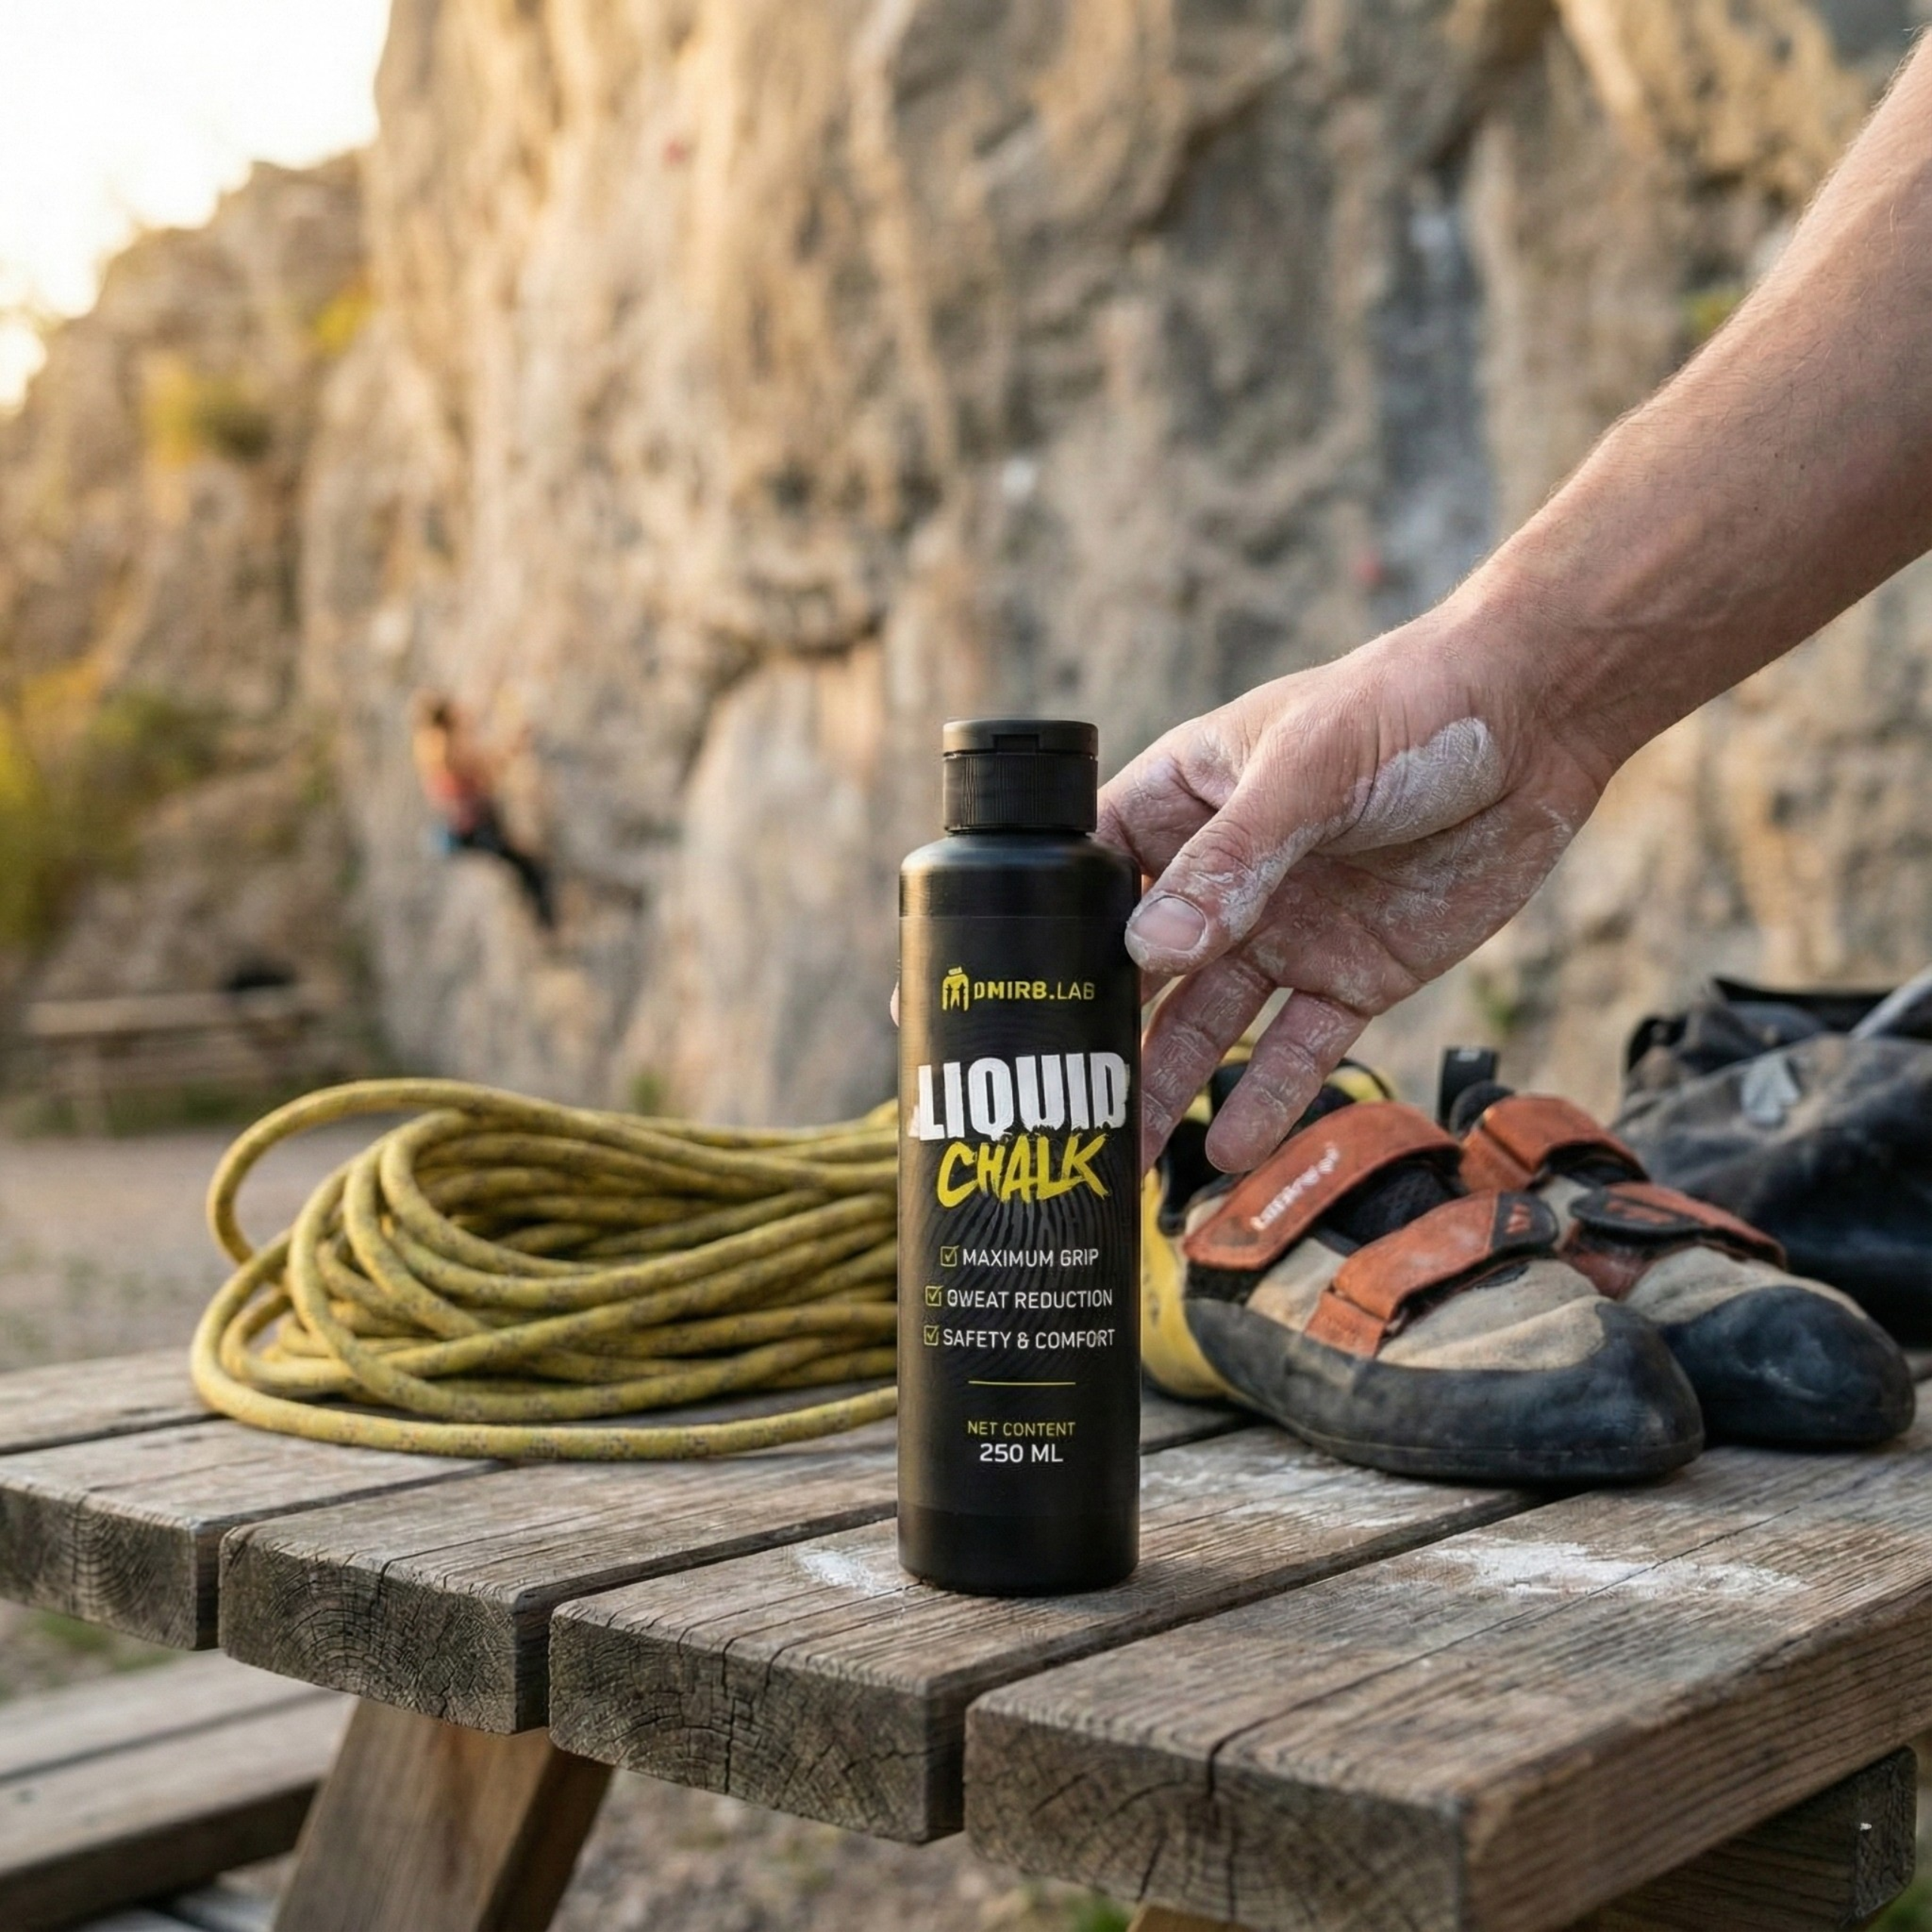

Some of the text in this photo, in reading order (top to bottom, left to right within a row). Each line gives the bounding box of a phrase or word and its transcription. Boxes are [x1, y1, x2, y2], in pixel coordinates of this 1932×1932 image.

[909, 1052, 1131, 1141] LIQUID
[937, 1134, 1112, 1208] CHALK
[962, 1248, 1100, 1267] MAXIMUM GRIP
[1014, 1288, 1113, 1309] REDUCTION
[943, 1329, 1115, 1349] SAFETY & COMFORT
[968, 1420, 1076, 1437] NET CONTENT
[980, 1443, 1064, 1463] 250 ML
